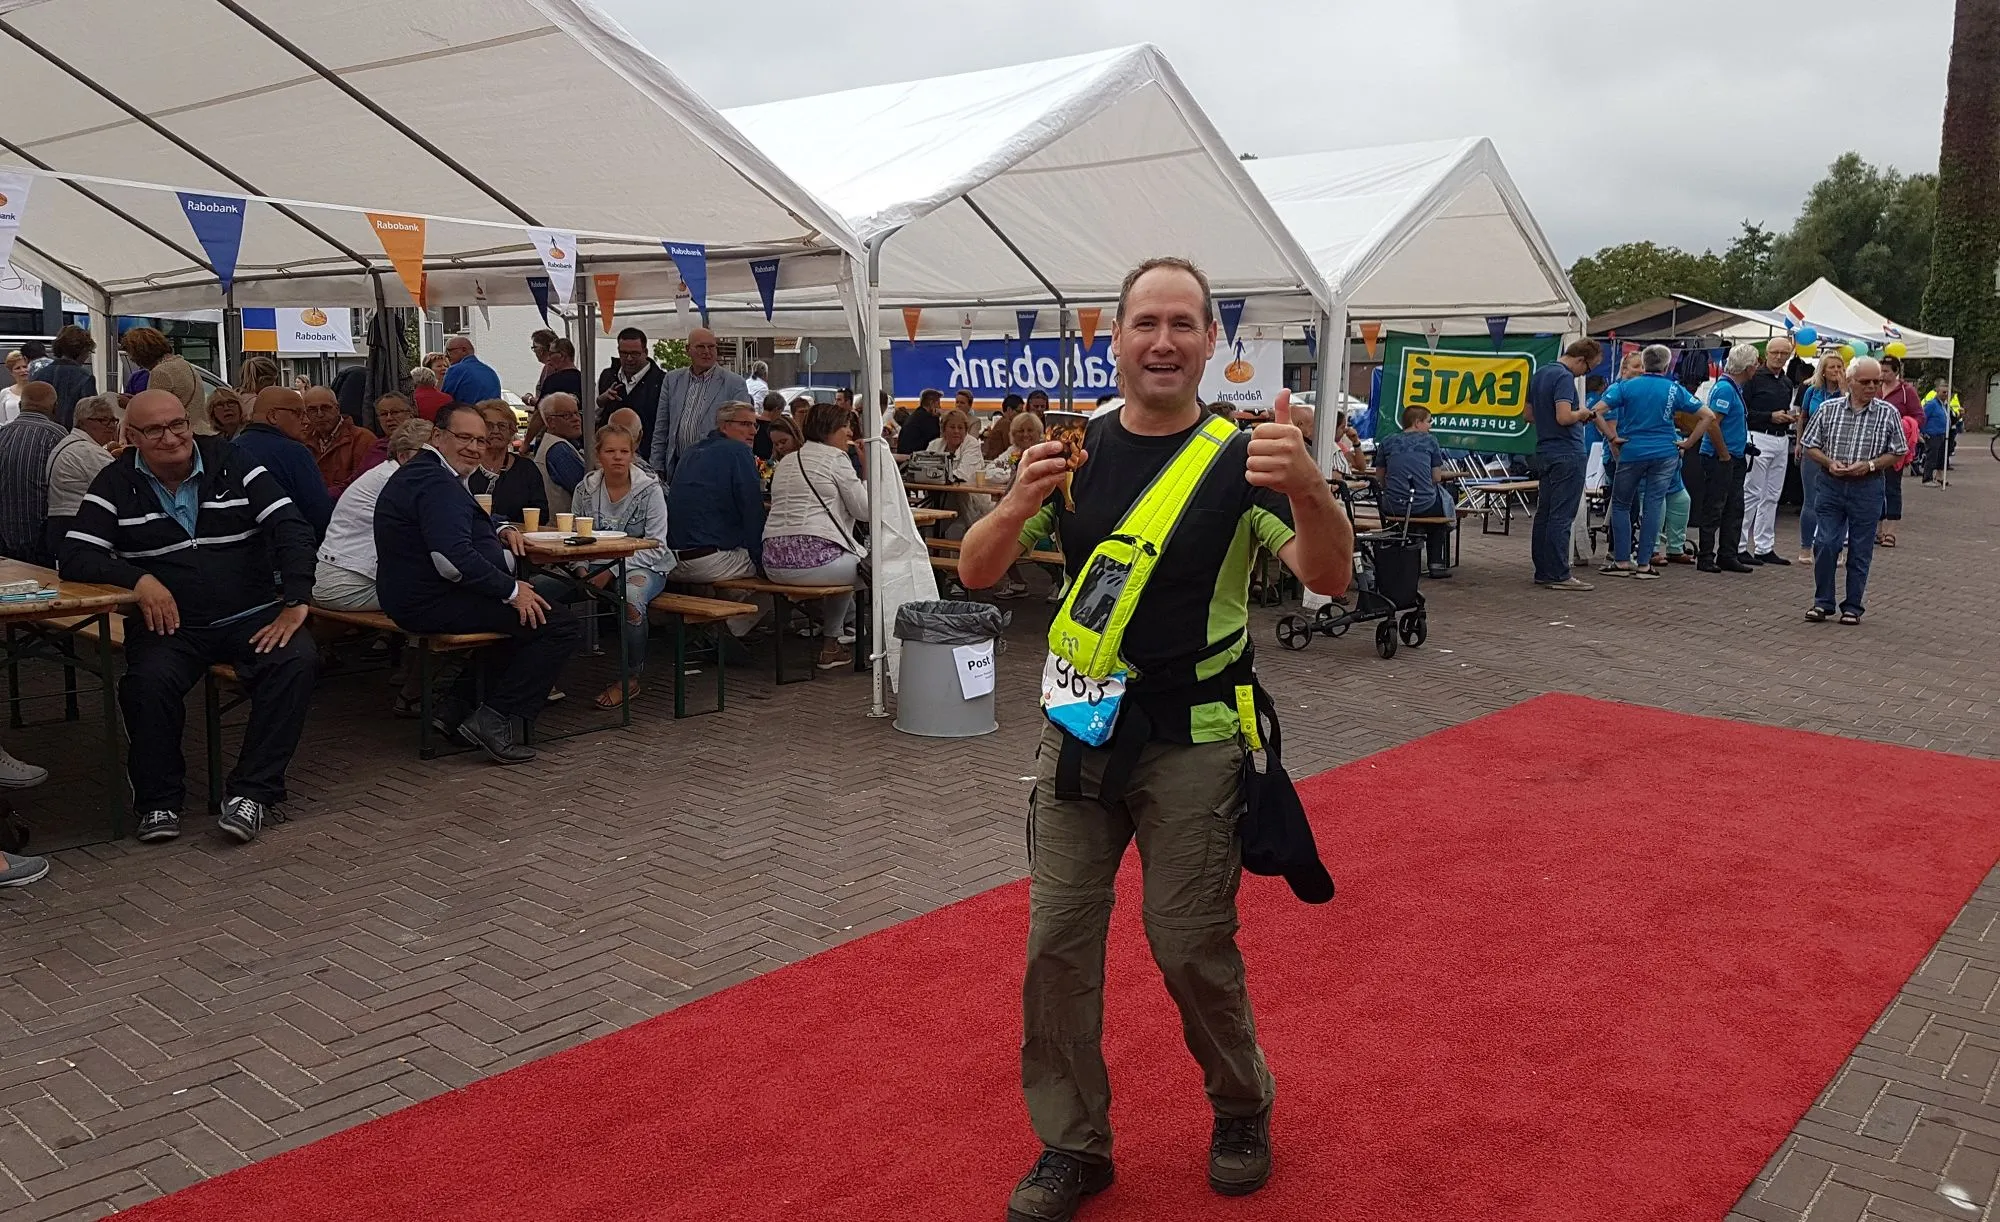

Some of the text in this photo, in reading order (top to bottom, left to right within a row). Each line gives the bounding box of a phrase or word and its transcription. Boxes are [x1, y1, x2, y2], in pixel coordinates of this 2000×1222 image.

[187, 200, 239, 214] Rabobank
[376, 220, 419, 232] Rabobank
[671, 246, 702, 257] Rabobank
[547, 261, 573, 269] Rabobank
[754, 265, 776, 273] Rabobank
[295, 331, 337, 341] Rabobank
[967, 655, 991, 671] Post
